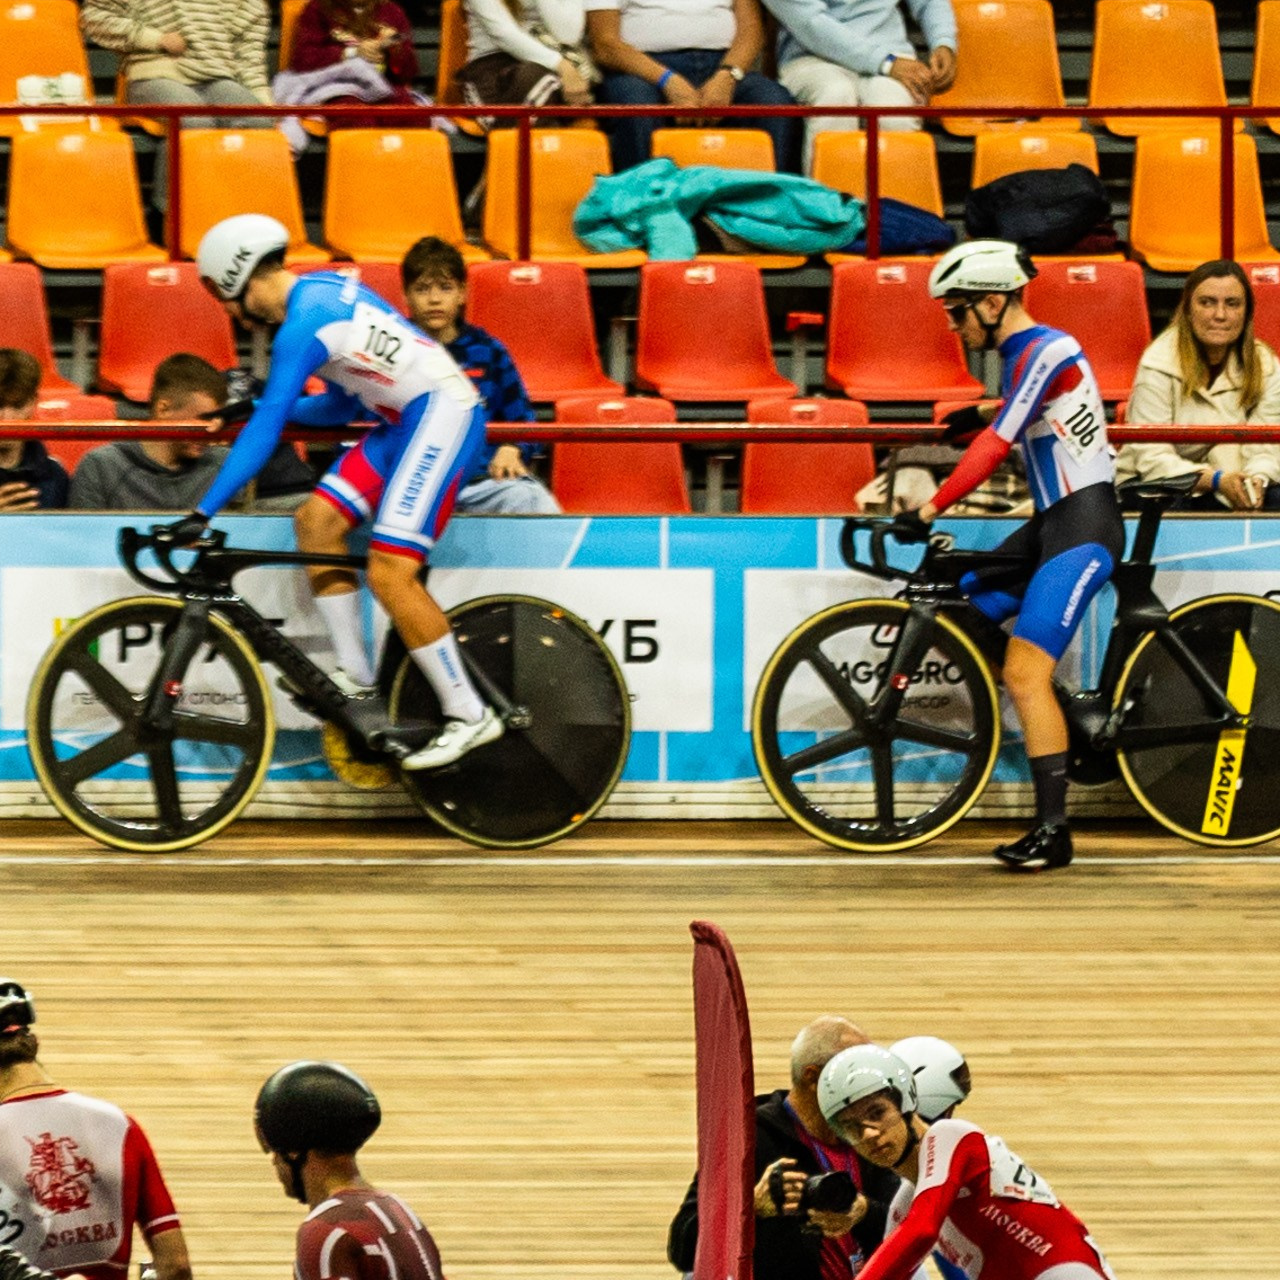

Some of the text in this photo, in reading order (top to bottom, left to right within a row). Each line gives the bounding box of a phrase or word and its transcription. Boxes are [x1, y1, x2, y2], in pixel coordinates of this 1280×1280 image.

[364, 324, 402, 365] 102
[1064, 403, 1100, 448] 106
[396, 444, 442, 518] LOKOSPHINX
[1209, 746, 1236, 828] MAVIC
[978, 1204, 1054, 1257] МОСКВА
